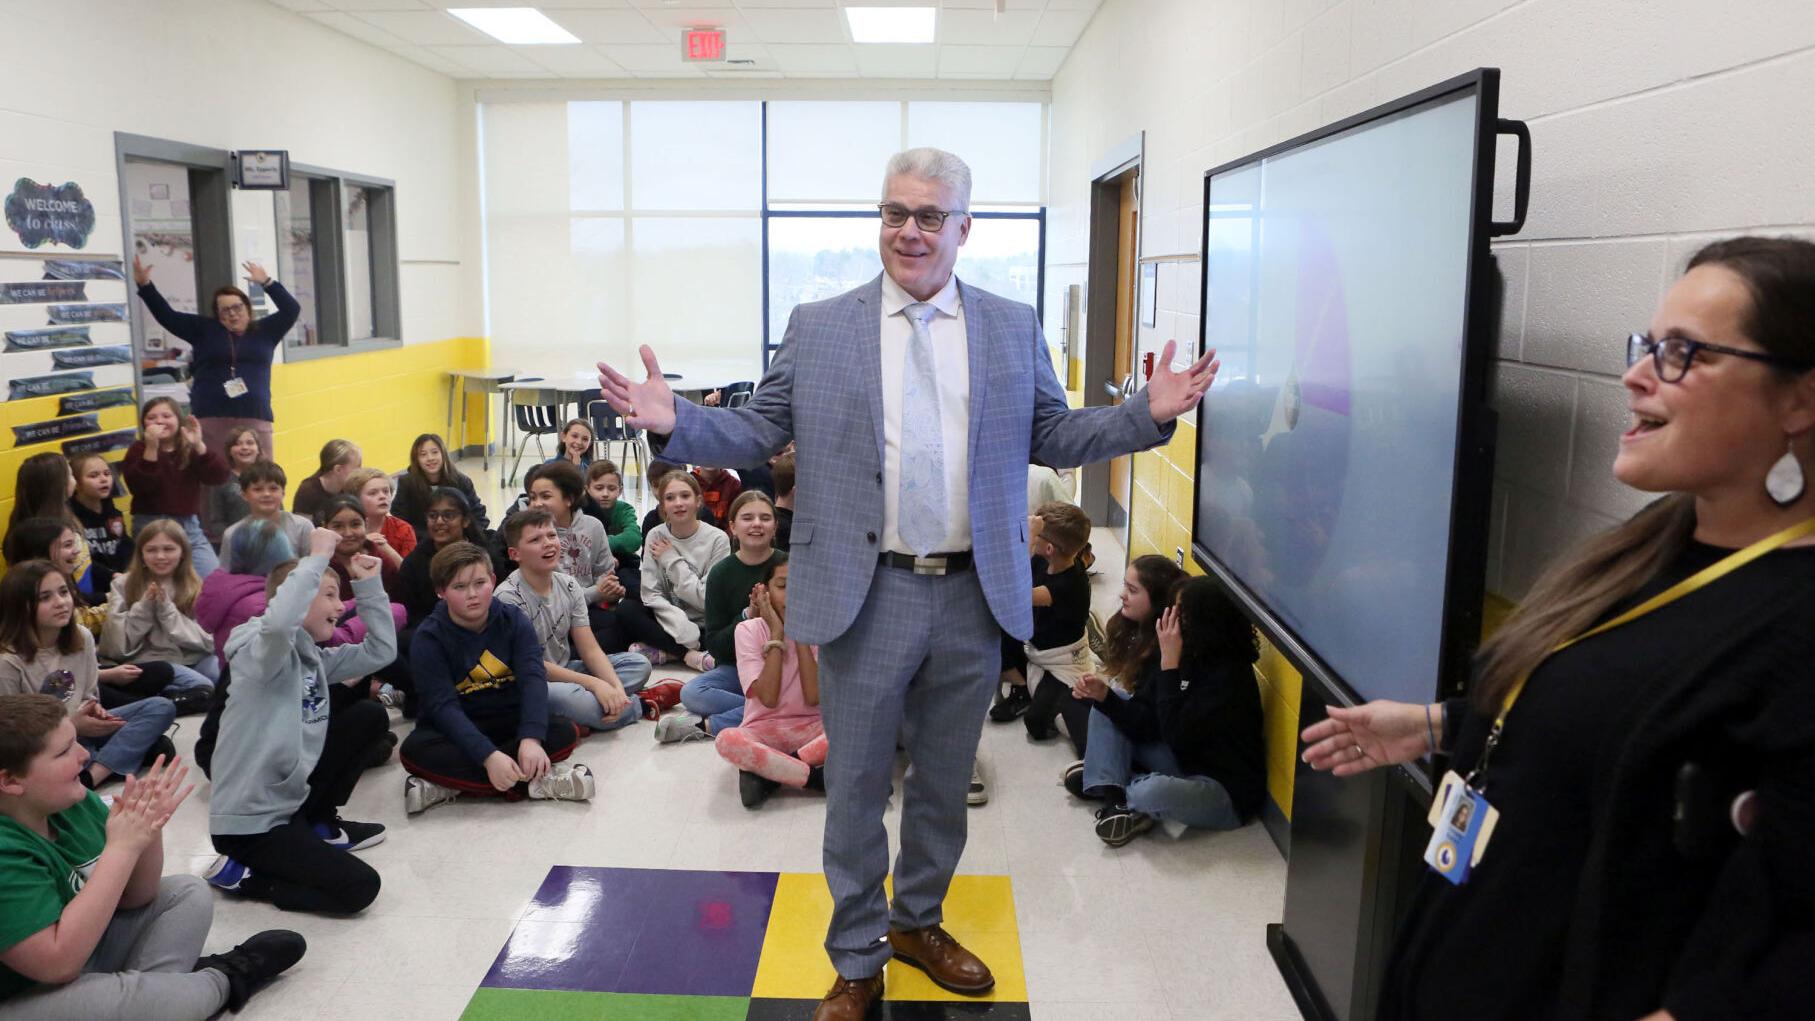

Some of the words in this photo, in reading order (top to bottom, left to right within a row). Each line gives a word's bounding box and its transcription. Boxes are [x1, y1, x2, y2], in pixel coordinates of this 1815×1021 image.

[688, 31, 720, 58] EXIT
[24, 198, 79, 213] WELCOME
[26, 214, 40, 230] to
